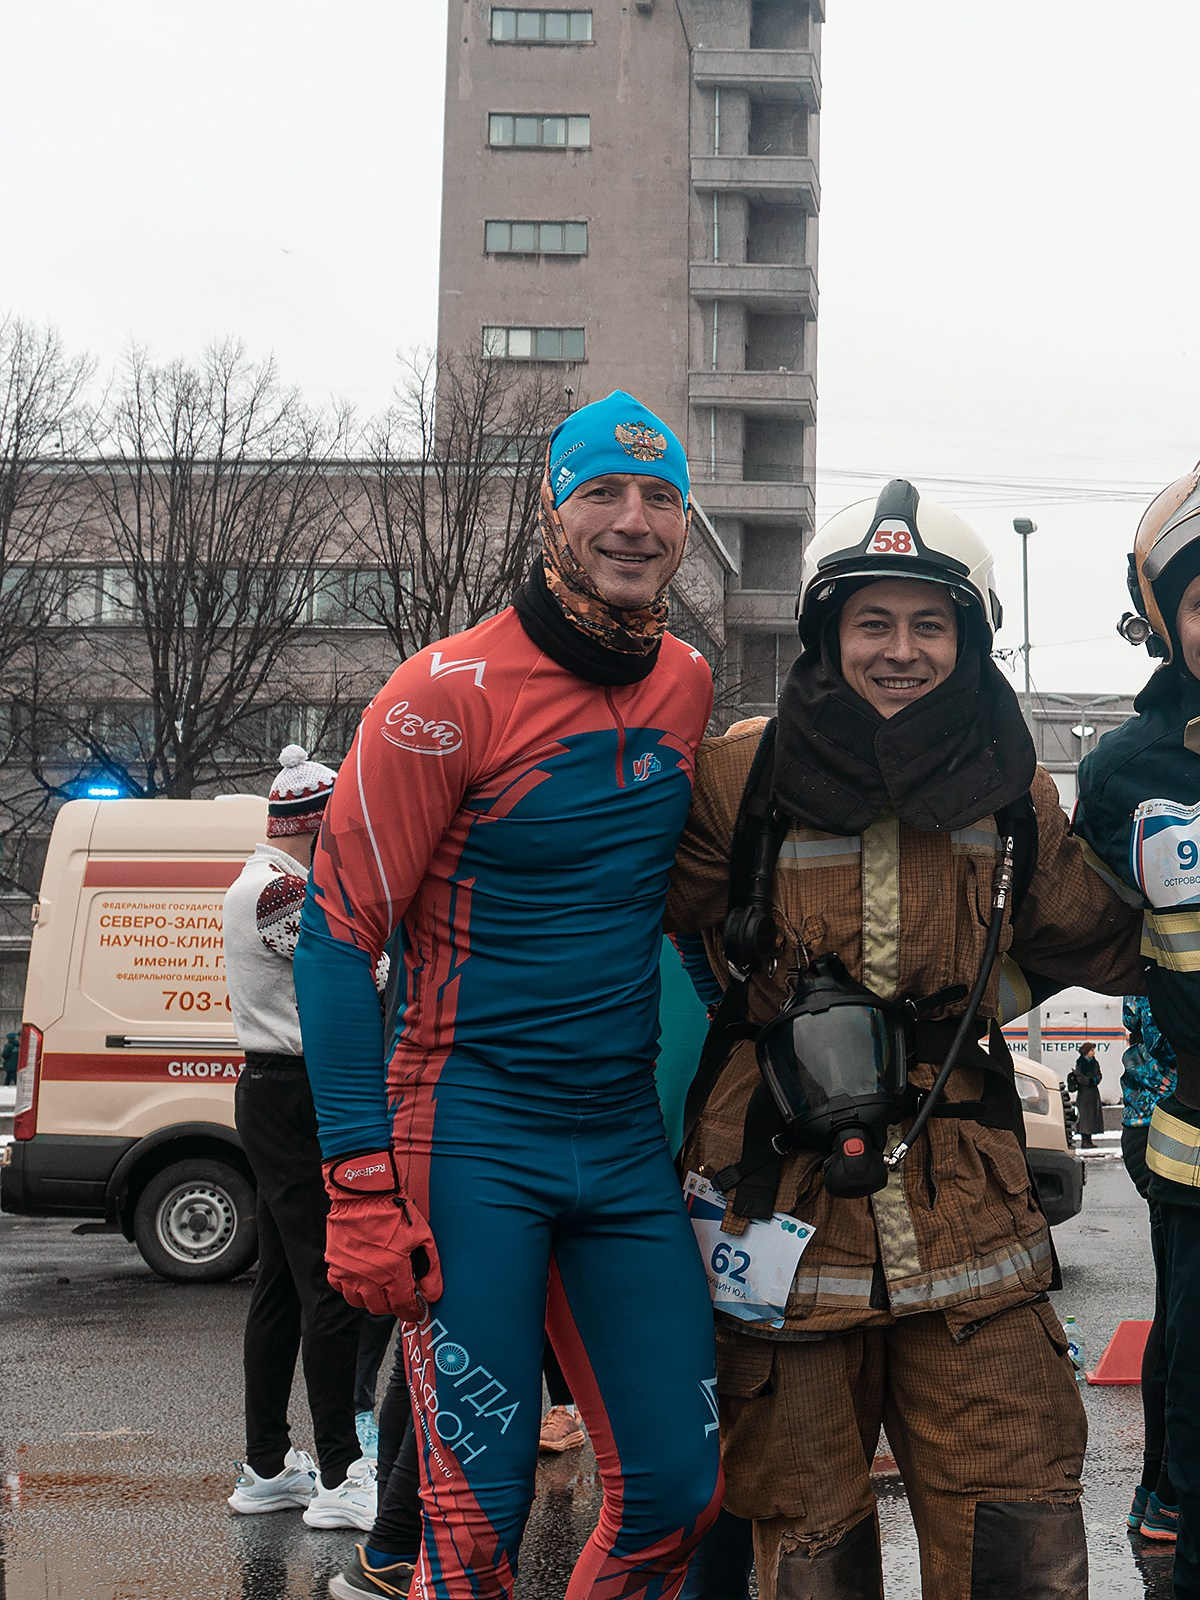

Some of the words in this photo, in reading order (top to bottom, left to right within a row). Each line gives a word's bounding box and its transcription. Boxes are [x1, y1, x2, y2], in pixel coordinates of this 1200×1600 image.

[556, 472, 576, 496] adidas
[873, 531, 912, 553] 58
[102, 902, 166, 910] ФЕДЕРАЛЬНОЕ
[100, 934, 224, 949] НАУЧНО-КЛИН
[134, 957, 187, 967] имени
[191, 955, 209, 968] Л.
[116, 973, 182, 981] ФЕДЕРАЛЬНОГО
[711, 1242, 751, 1284] 62
[414, 1575, 424, 1600] VIT
